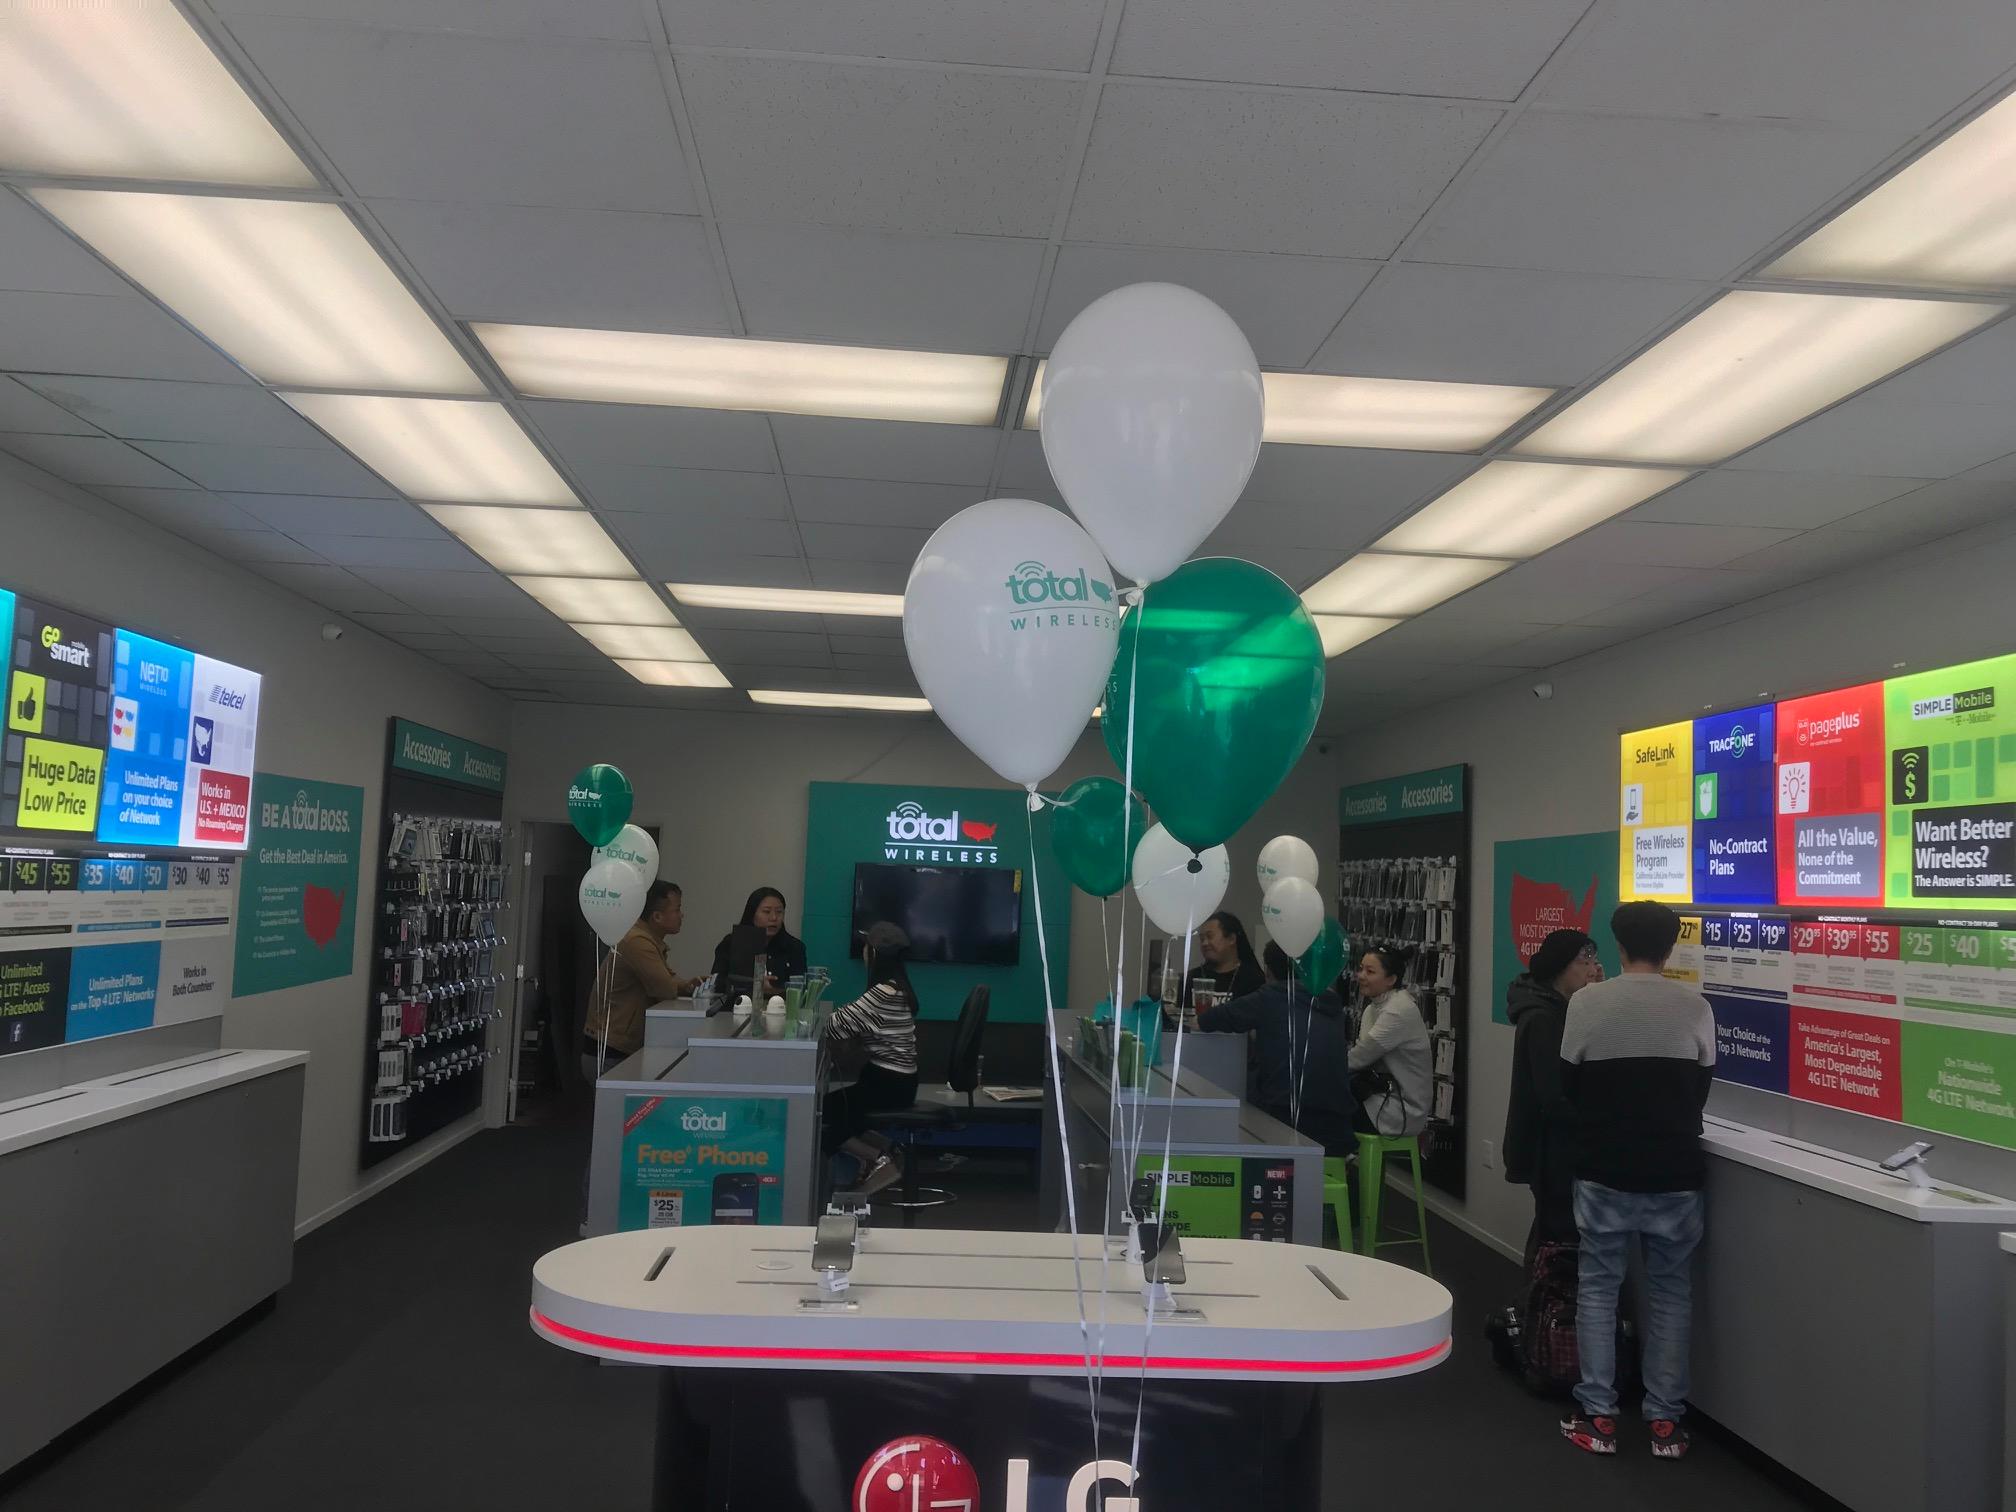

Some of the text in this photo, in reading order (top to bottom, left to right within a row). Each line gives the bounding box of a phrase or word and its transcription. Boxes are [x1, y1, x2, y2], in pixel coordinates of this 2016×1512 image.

[1005, 568, 1089, 605] total
[50, 643, 90, 668] smart
[218, 688, 246, 710] telcel
[1914, 691, 1992, 716] SIMPLE Mobile
[1810, 711, 1860, 740] pageplus
[1709, 733, 1754, 753] TRACFONE
[403, 732, 502, 781] Accessories Accessories
[1635, 742, 1675, 764] SafeLink
[28, 755, 96, 786] Huge Data
[125, 770, 178, 792] Unlimited Plans
[122, 792, 173, 808] on your choice
[201, 782, 231, 800] Works in
[569, 788, 588, 800] total
[1345, 779, 1454, 816] Accessories Accessories
[24, 788, 86, 815] Low Price
[200, 800, 212, 815] U.S.
[219, 802, 245, 819] MEXICO
[119, 808, 160, 825] of Network
[262, 800, 350, 833] BE A total BOSS.
[886, 810, 959, 842] total
[1798, 827, 1878, 848] All the Value,
[1915, 818, 2013, 842] Want Better
[1636, 834, 1684, 850] Free Wireless
[1709, 837, 1767, 855] No-Contract
[260, 849, 348, 864] Get the Best Deal in America.
[606, 847, 635, 862] total
[885, 848, 998, 864] WIRELESS
[1636, 854, 1668, 871] Program
[1798, 851, 1854, 866] None of the
[1915, 846, 1989, 869] Wireless?
[16, 860, 71, 886] $45 $55
[84, 862, 161, 885] $35 $40 $50
[172, 866, 230, 885] $30 $40 $55
[1709, 859, 1735, 876] Plans
[1799, 871, 1861, 886] Commitment
[1915, 874, 2015, 887] The Answer is SIMPLE.
[1535, 907, 1565, 923] LARGEST,
[1520, 923, 1537, 938] MOST
[1706, 921, 1721, 941] $15
[1733, 922, 1751, 943] $25
[1521, 942, 1530, 955] 4G
[1866, 929, 1889, 953] $55
[1907, 932, 1933, 956] $25
[1950, 934, 1979, 959] $40
[1, 961, 43, 979] Unlimited
[183, 966, 200, 978] Works
[23, 982, 50, 996] Access
[89, 974, 143, 991] Unlimited Plans
[173, 984, 186, 996] Both
[4, 999, 44, 1015] Facebook
[88, 995, 100, 1011] Top
[102, 994, 108, 1006] 4
[123, 988, 155, 1003] Networks
[1717, 1024, 1732, 1038] Your
[1733, 1026, 1756, 1042] Choice
[1761, 1035, 1771, 1045] the
[1798, 1022, 1890, 1045] Take Advantage of Great Deals on
[1717, 1040, 1771, 1062] Top 3 Networks
[1805, 1037, 1882, 1064] America's Largest,
[1805, 1054, 1882, 1081] Most Dependable
[1808, 1072, 1820, 1085] 4G
[1840, 1078, 1879, 1098] Network
[1927, 1088, 1942, 1104] 4G
[681, 1112, 726, 1131] total
[698, 1145, 768, 1165] Phone
[1192, 1173, 1232, 1185] Mobile
[1266, 1170, 1285, 1178] NEW!
[654, 1199, 674, 1211] $25
